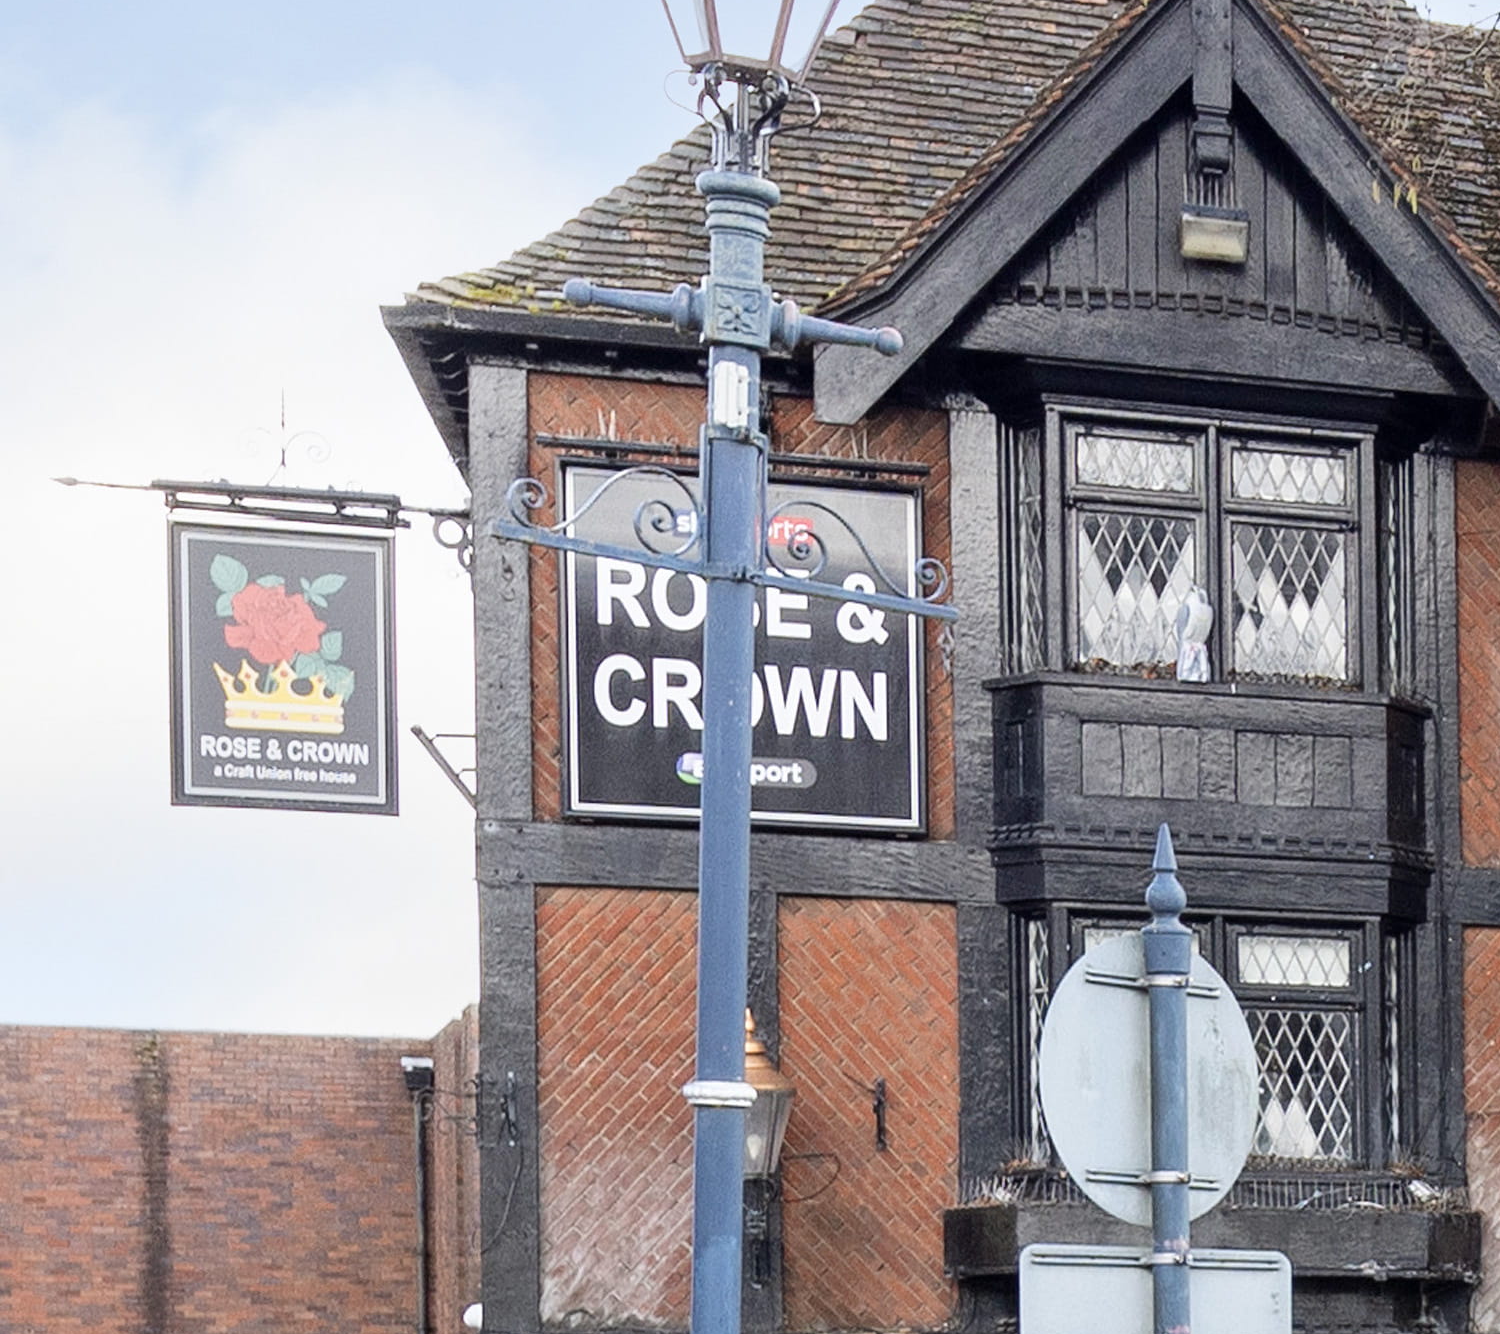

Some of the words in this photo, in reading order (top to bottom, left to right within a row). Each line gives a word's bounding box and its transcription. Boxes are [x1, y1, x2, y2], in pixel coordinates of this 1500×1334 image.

[595, 557, 811, 639] ROE
[836, 572, 889, 645] &
[201, 734, 261, 759] ROSE
[266, 738, 282, 761] &
[287, 740, 369, 765] CROWN
